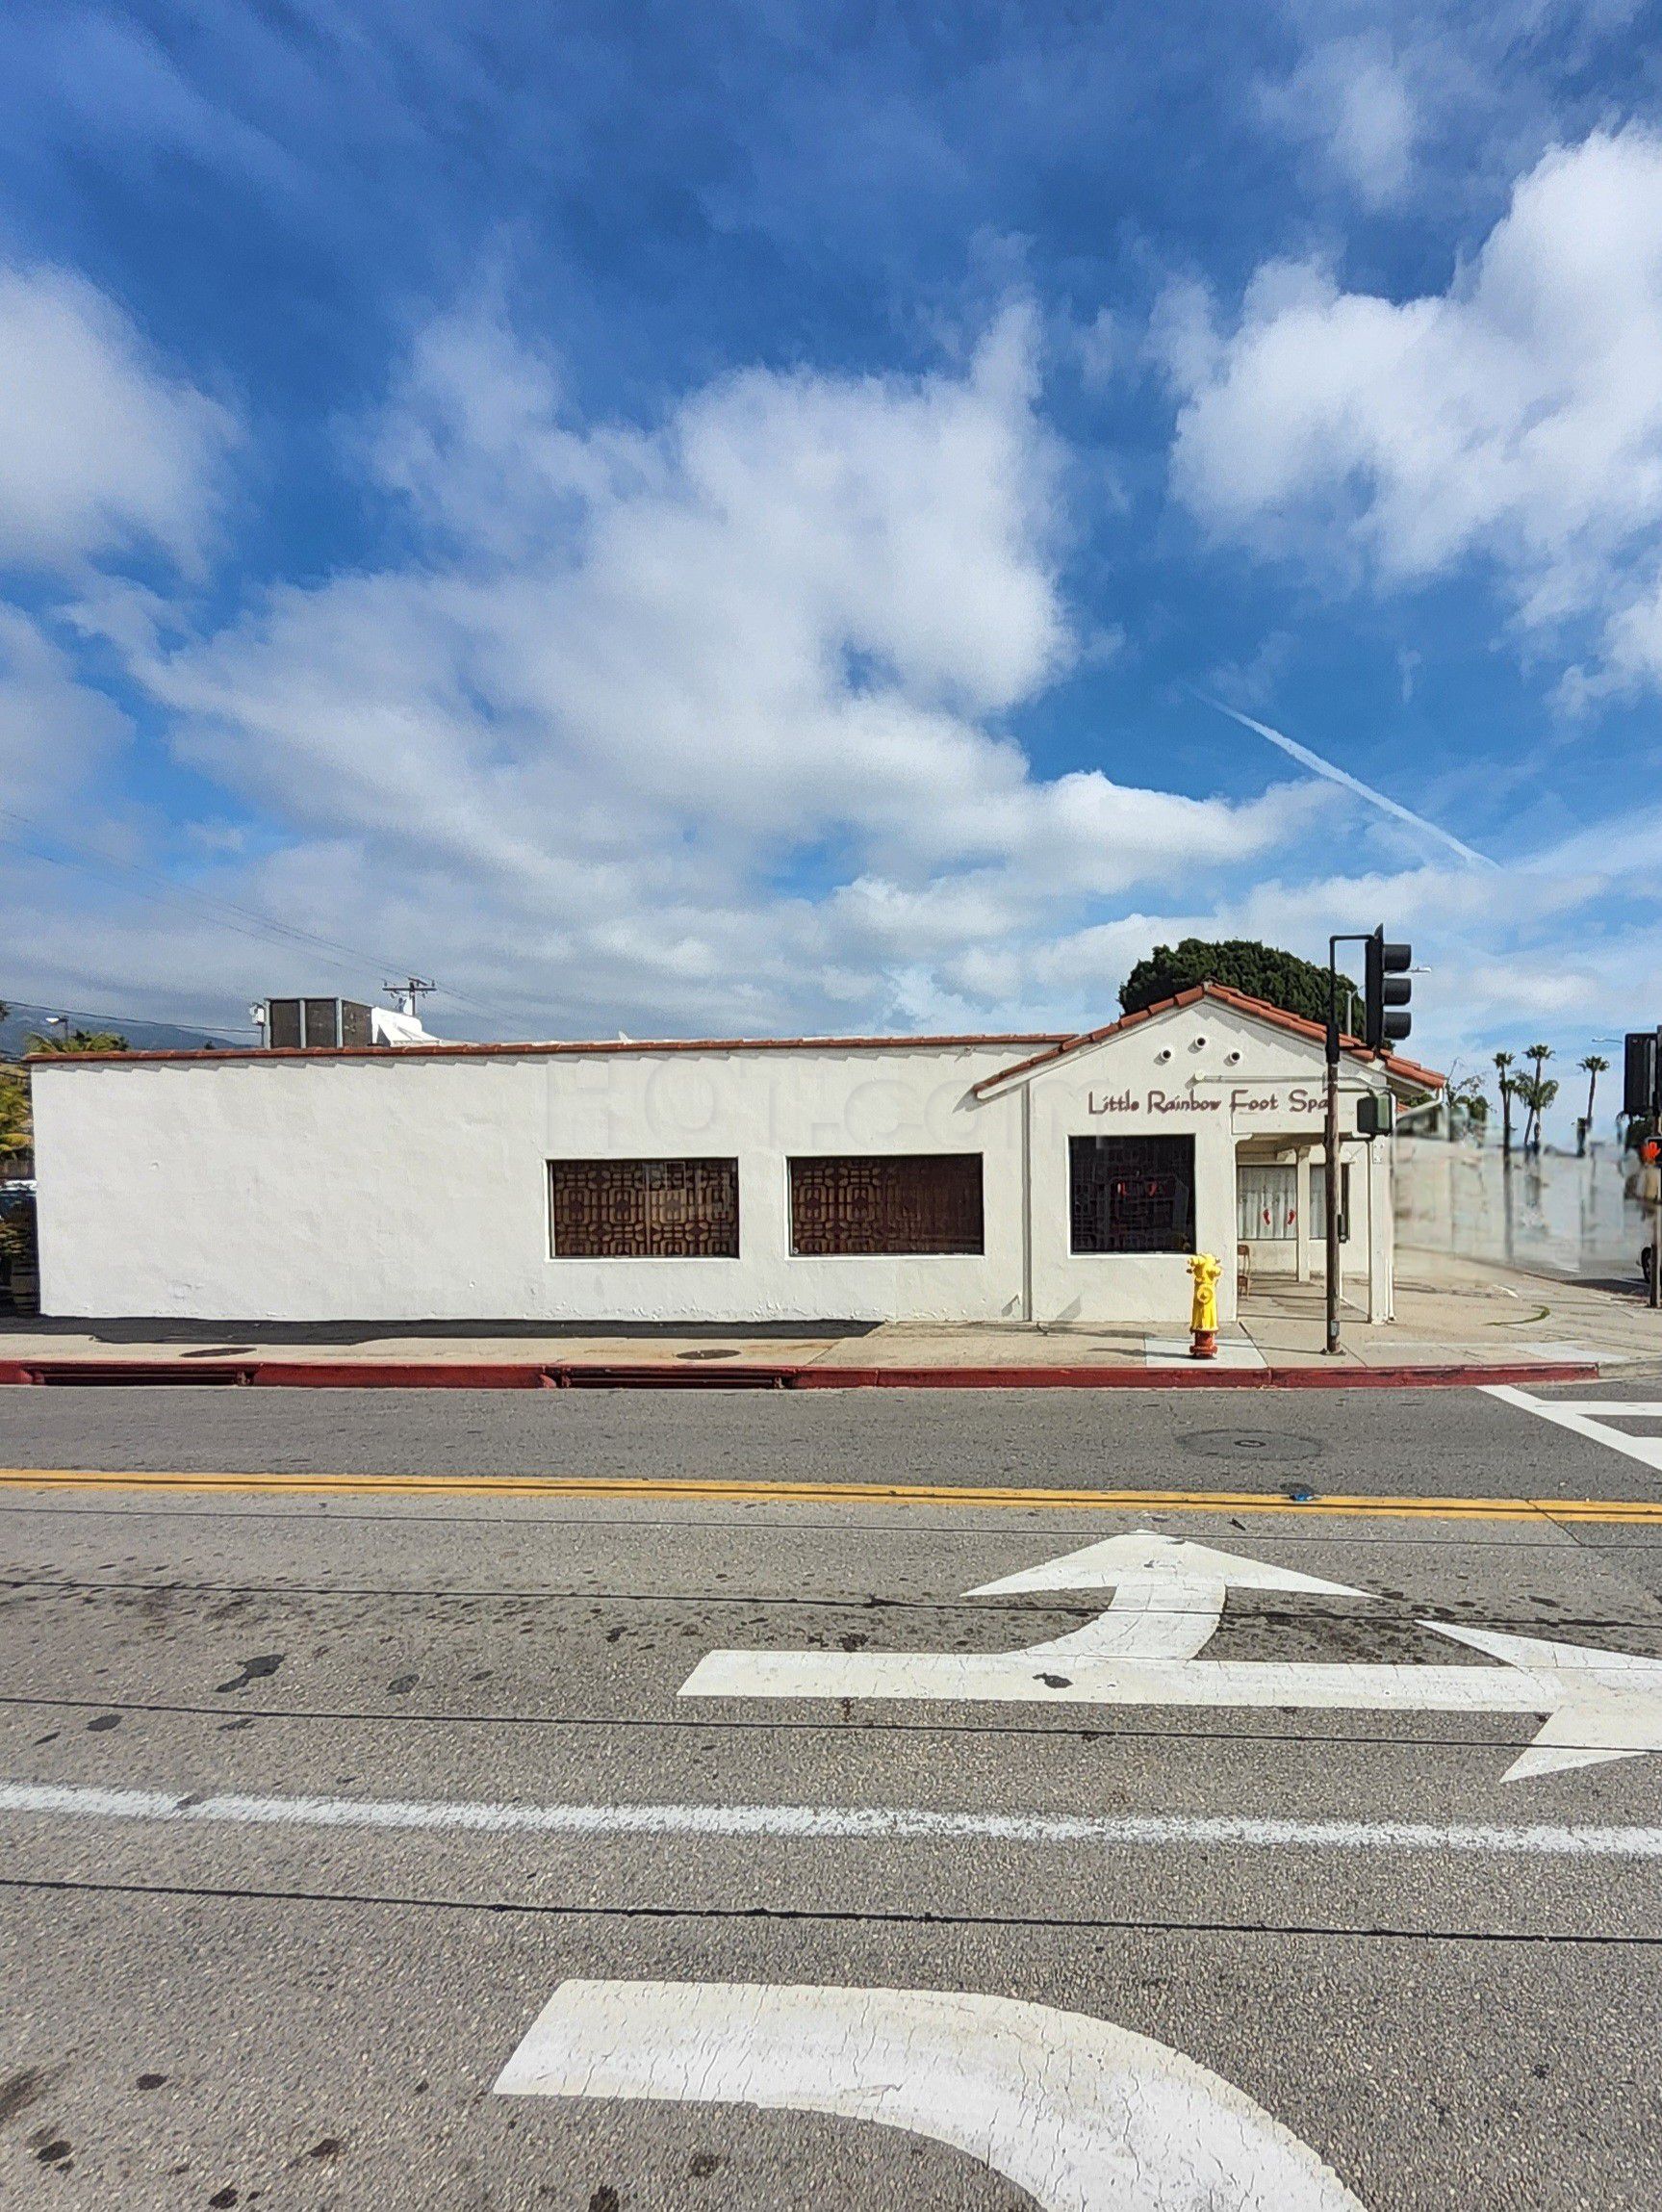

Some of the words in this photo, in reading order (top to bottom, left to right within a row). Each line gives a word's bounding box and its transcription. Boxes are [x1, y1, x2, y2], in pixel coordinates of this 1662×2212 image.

[1088, 1089, 1139, 1115] Little
[1147, 1087, 1221, 1114] Rainbow
[1229, 1089, 1279, 1113] Foot
[1288, 1089, 1329, 1113] Spa
